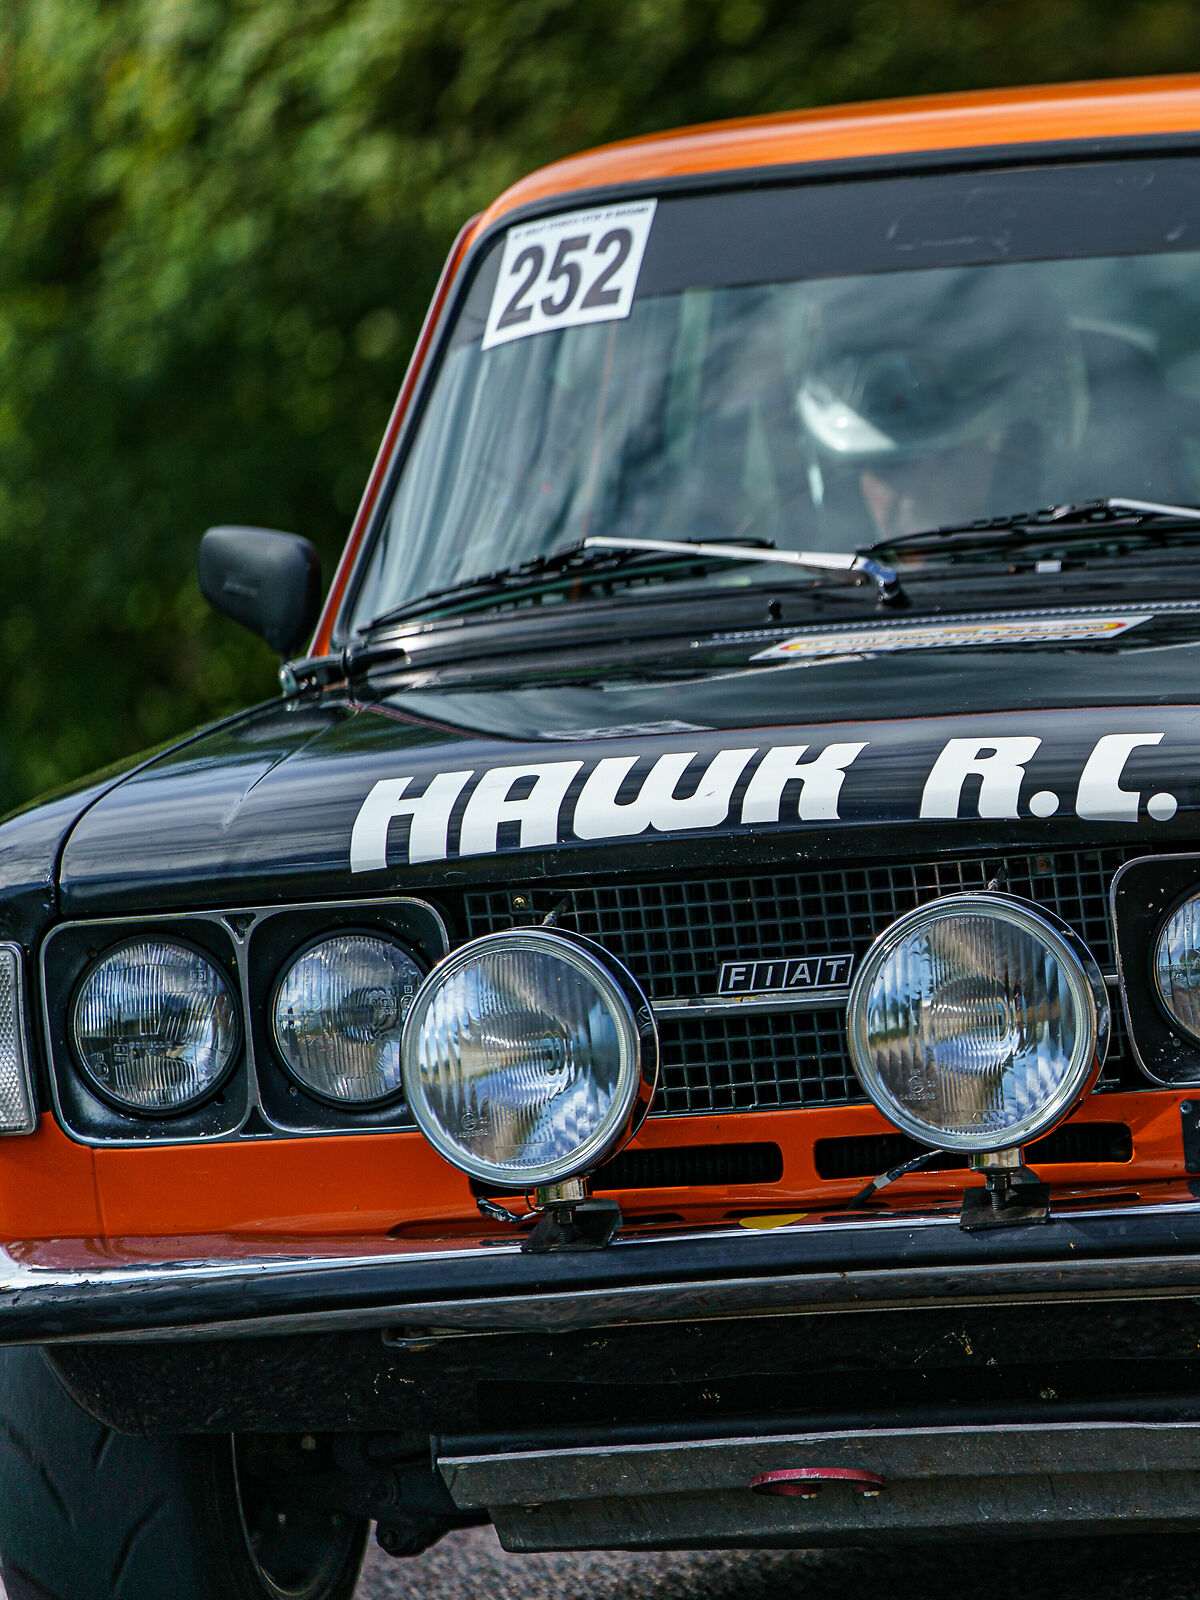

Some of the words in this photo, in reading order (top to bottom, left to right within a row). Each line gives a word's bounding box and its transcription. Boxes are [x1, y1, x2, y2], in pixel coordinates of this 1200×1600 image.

[497, 228, 633, 331] 252
[349, 741, 872, 875] HAWK
[919, 731, 1179, 824] R.C.
[728, 959, 847, 989] FIAT
